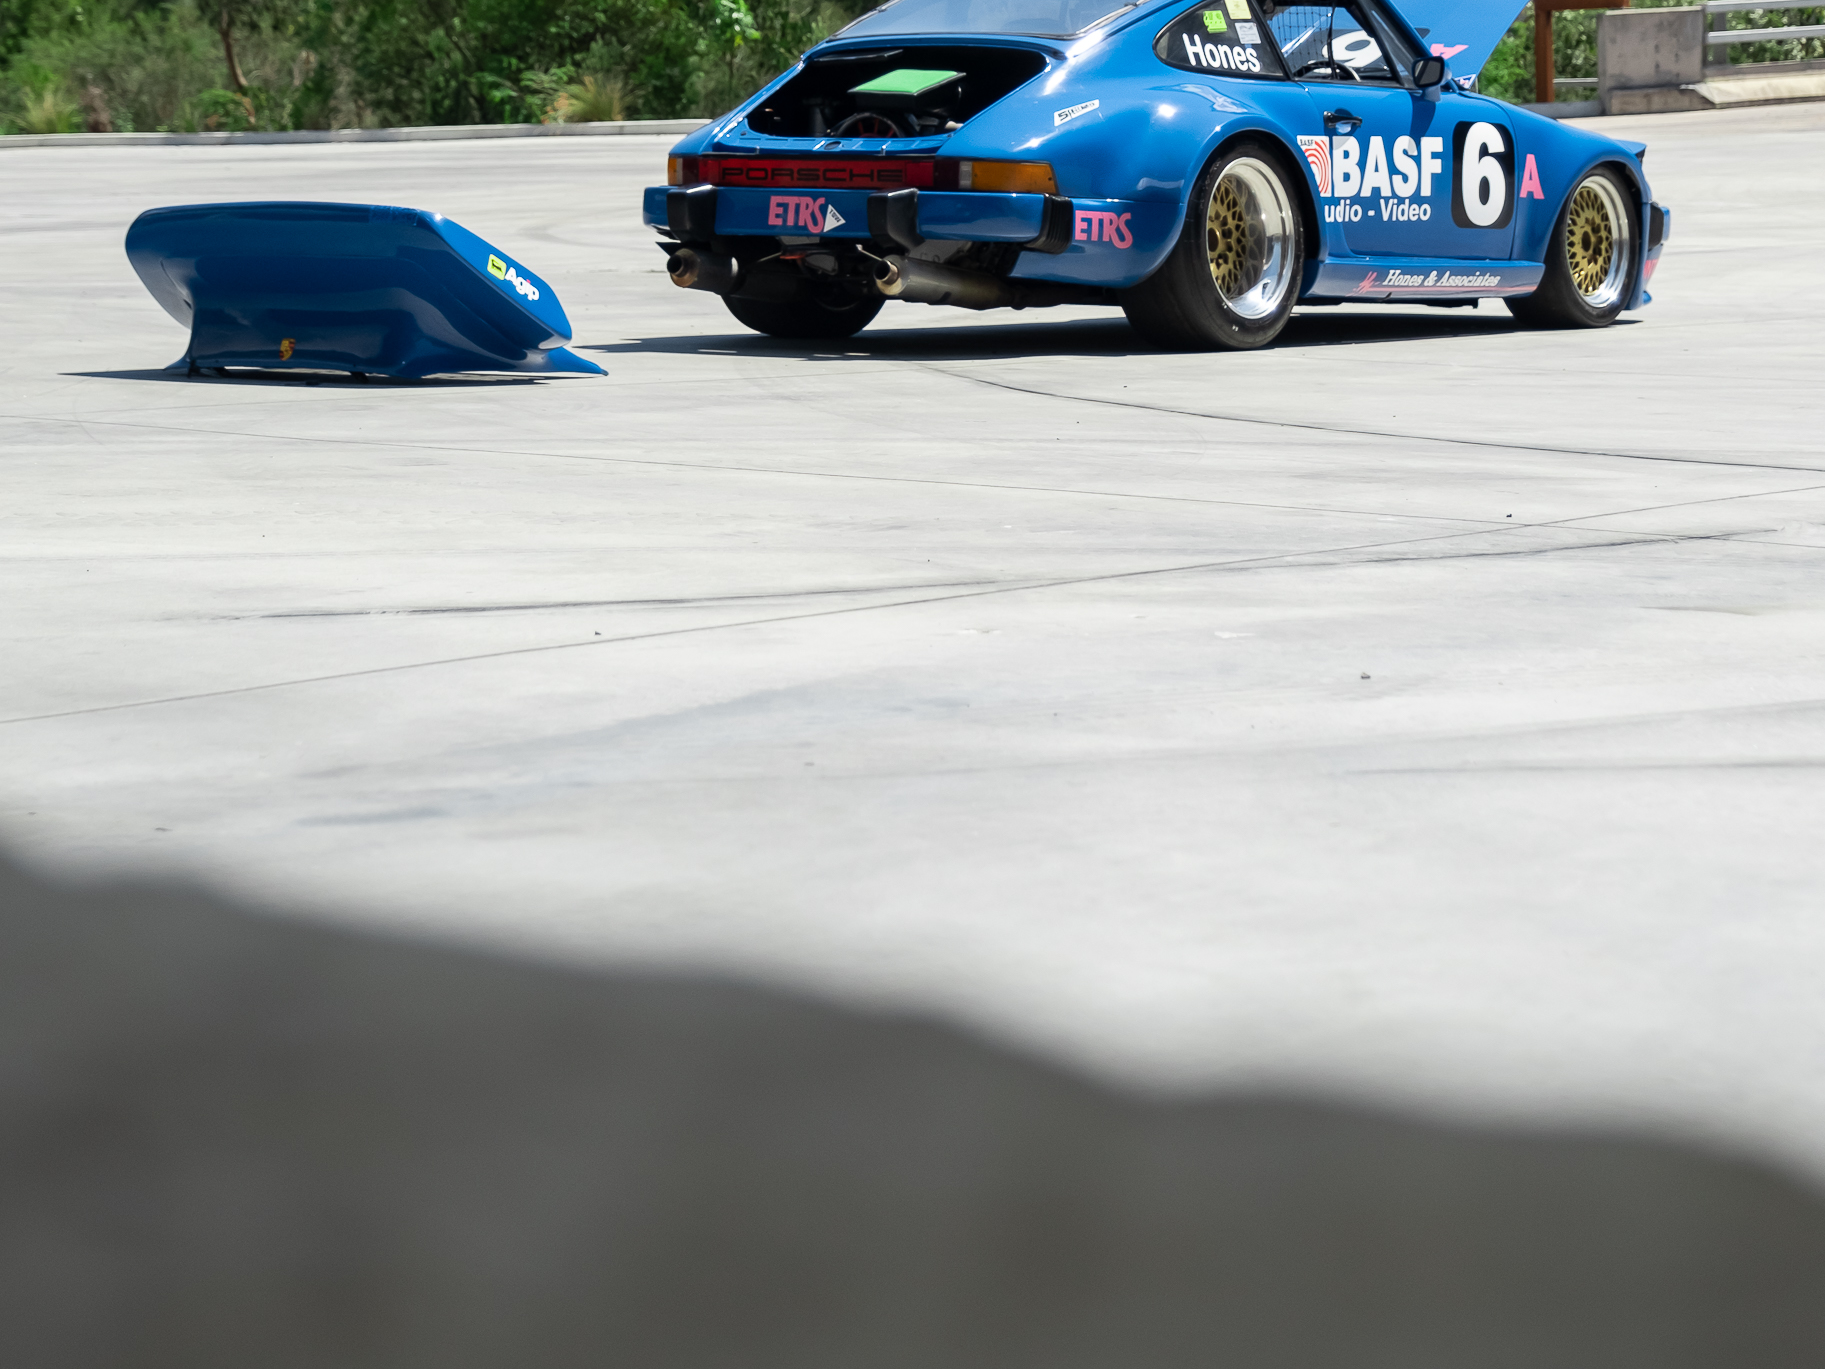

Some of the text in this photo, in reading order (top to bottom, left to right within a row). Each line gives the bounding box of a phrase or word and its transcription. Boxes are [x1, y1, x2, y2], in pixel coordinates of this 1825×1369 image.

[1182, 33, 1261, 73] Hones
[722, 167, 903, 182] PORSCHE
[1332, 135, 1443, 197] BASF
[1462, 122, 1506, 226] 6
[1520, 154, 1545, 200] A
[768, 195, 825, 233] ETRS
[1380, 198, 1431, 222] Video
[1075, 210, 1133, 249] ETRS
[504, 266, 540, 301] Agip
[1382, 269, 1501, 287] Hones & Associates
